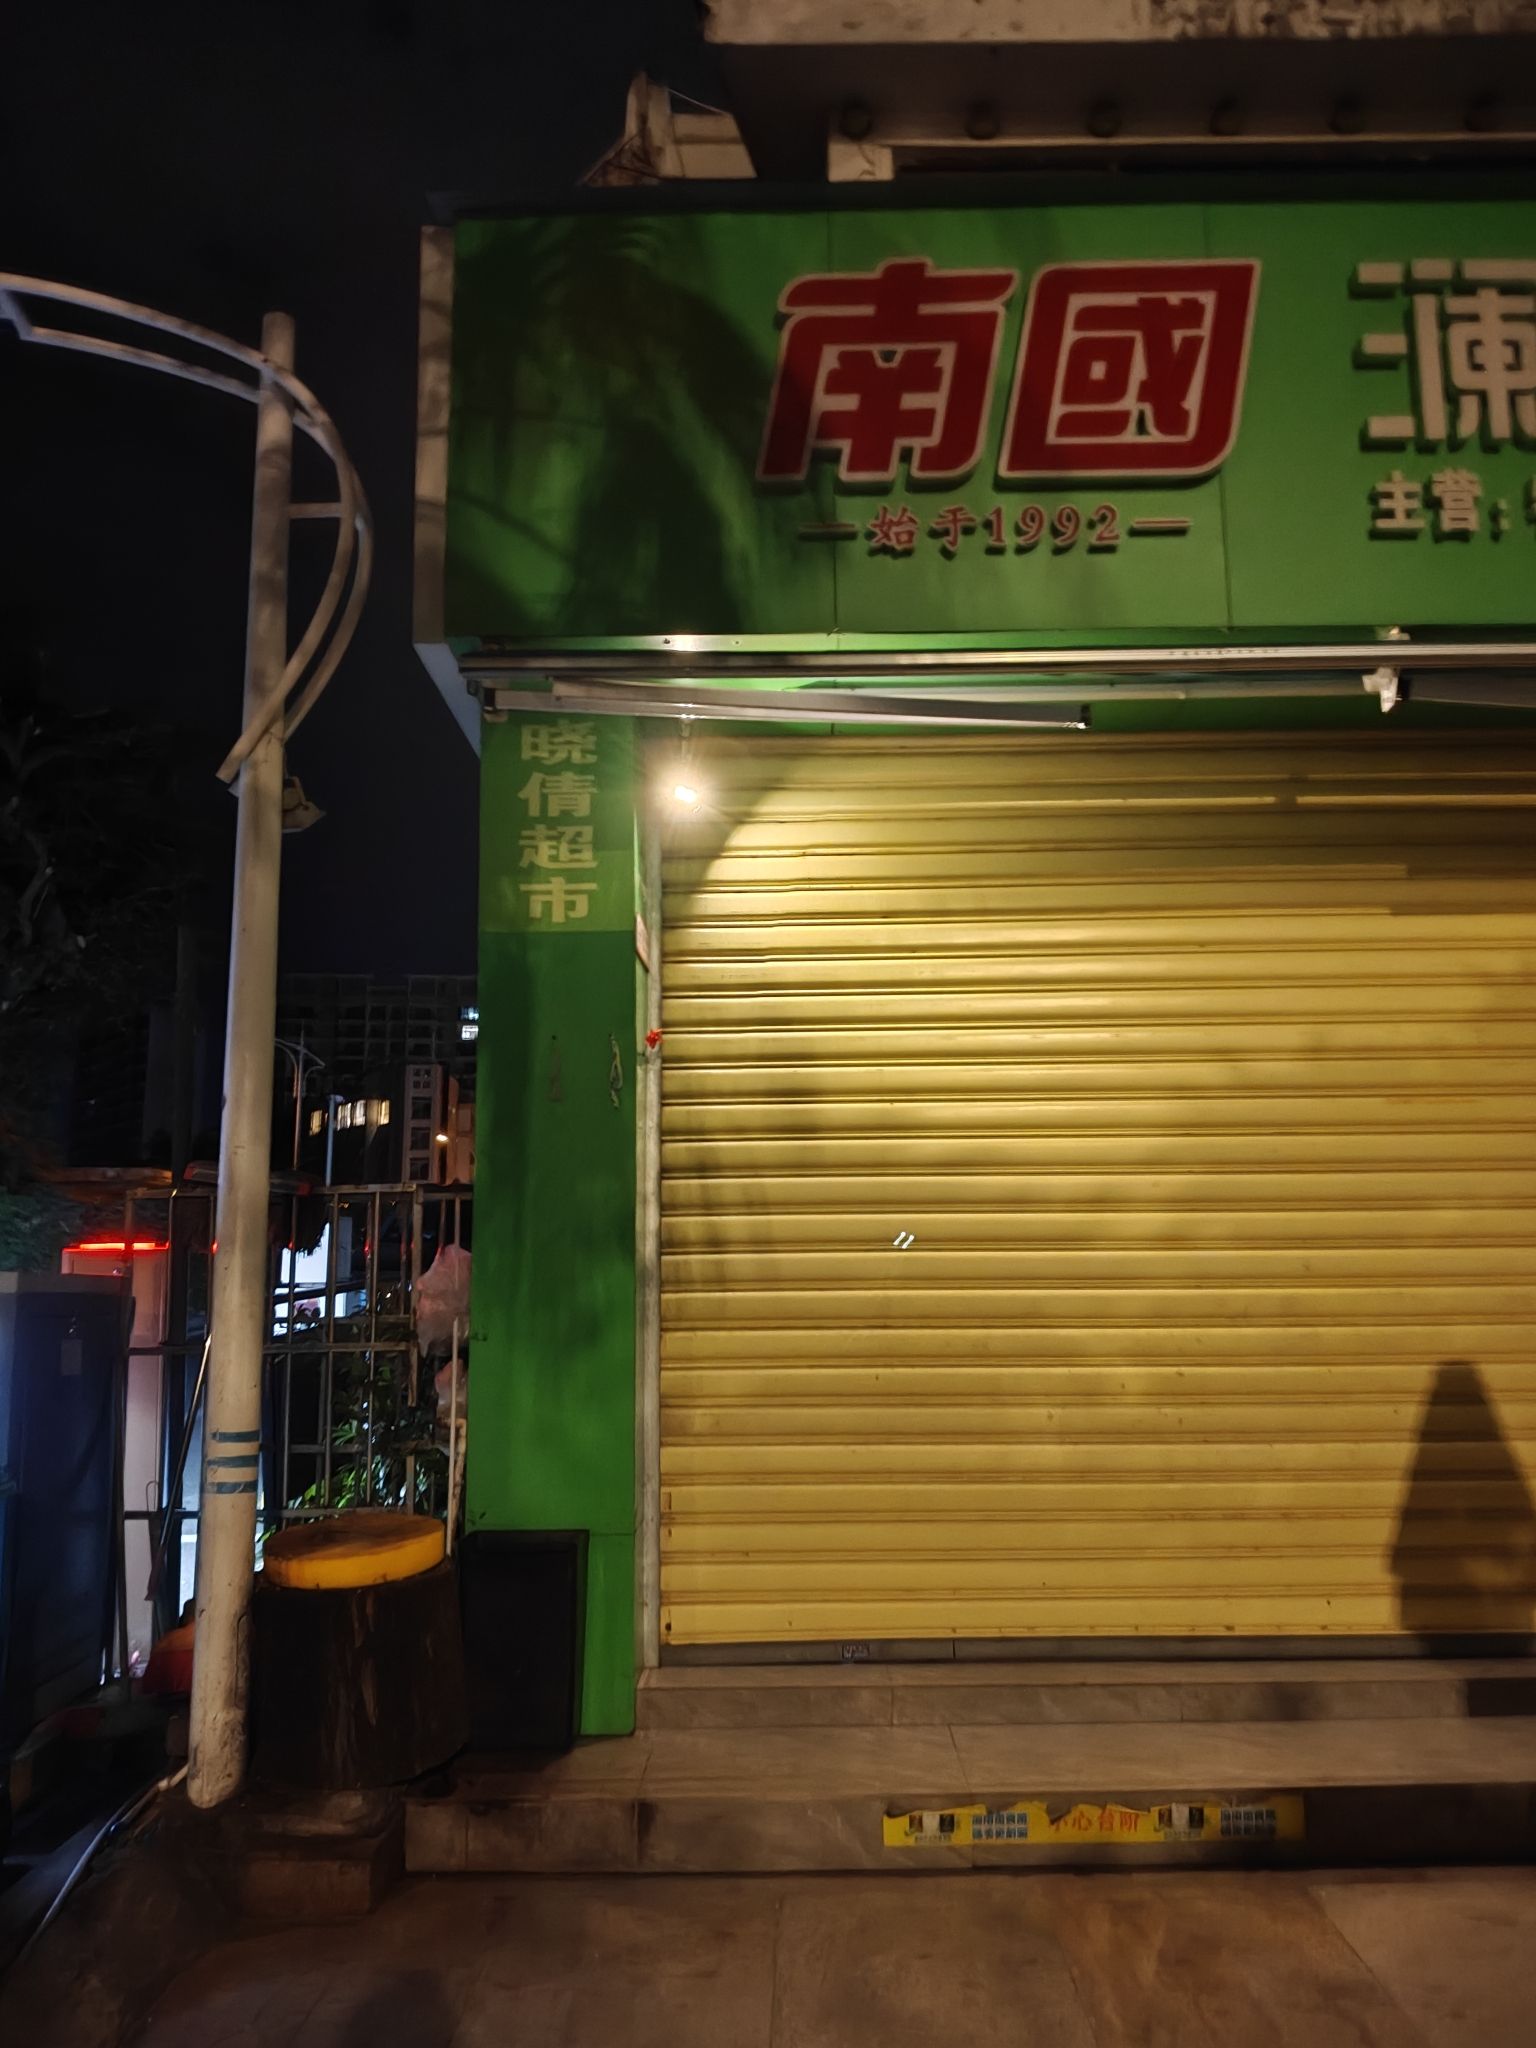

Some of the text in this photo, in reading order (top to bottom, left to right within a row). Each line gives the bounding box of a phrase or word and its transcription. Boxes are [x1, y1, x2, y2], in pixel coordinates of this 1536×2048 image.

[758, 258, 1261, 483] 南國
[1374, 467, 1536, 532] 主营:
[518, 718, 598, 923] 晓倩超市
